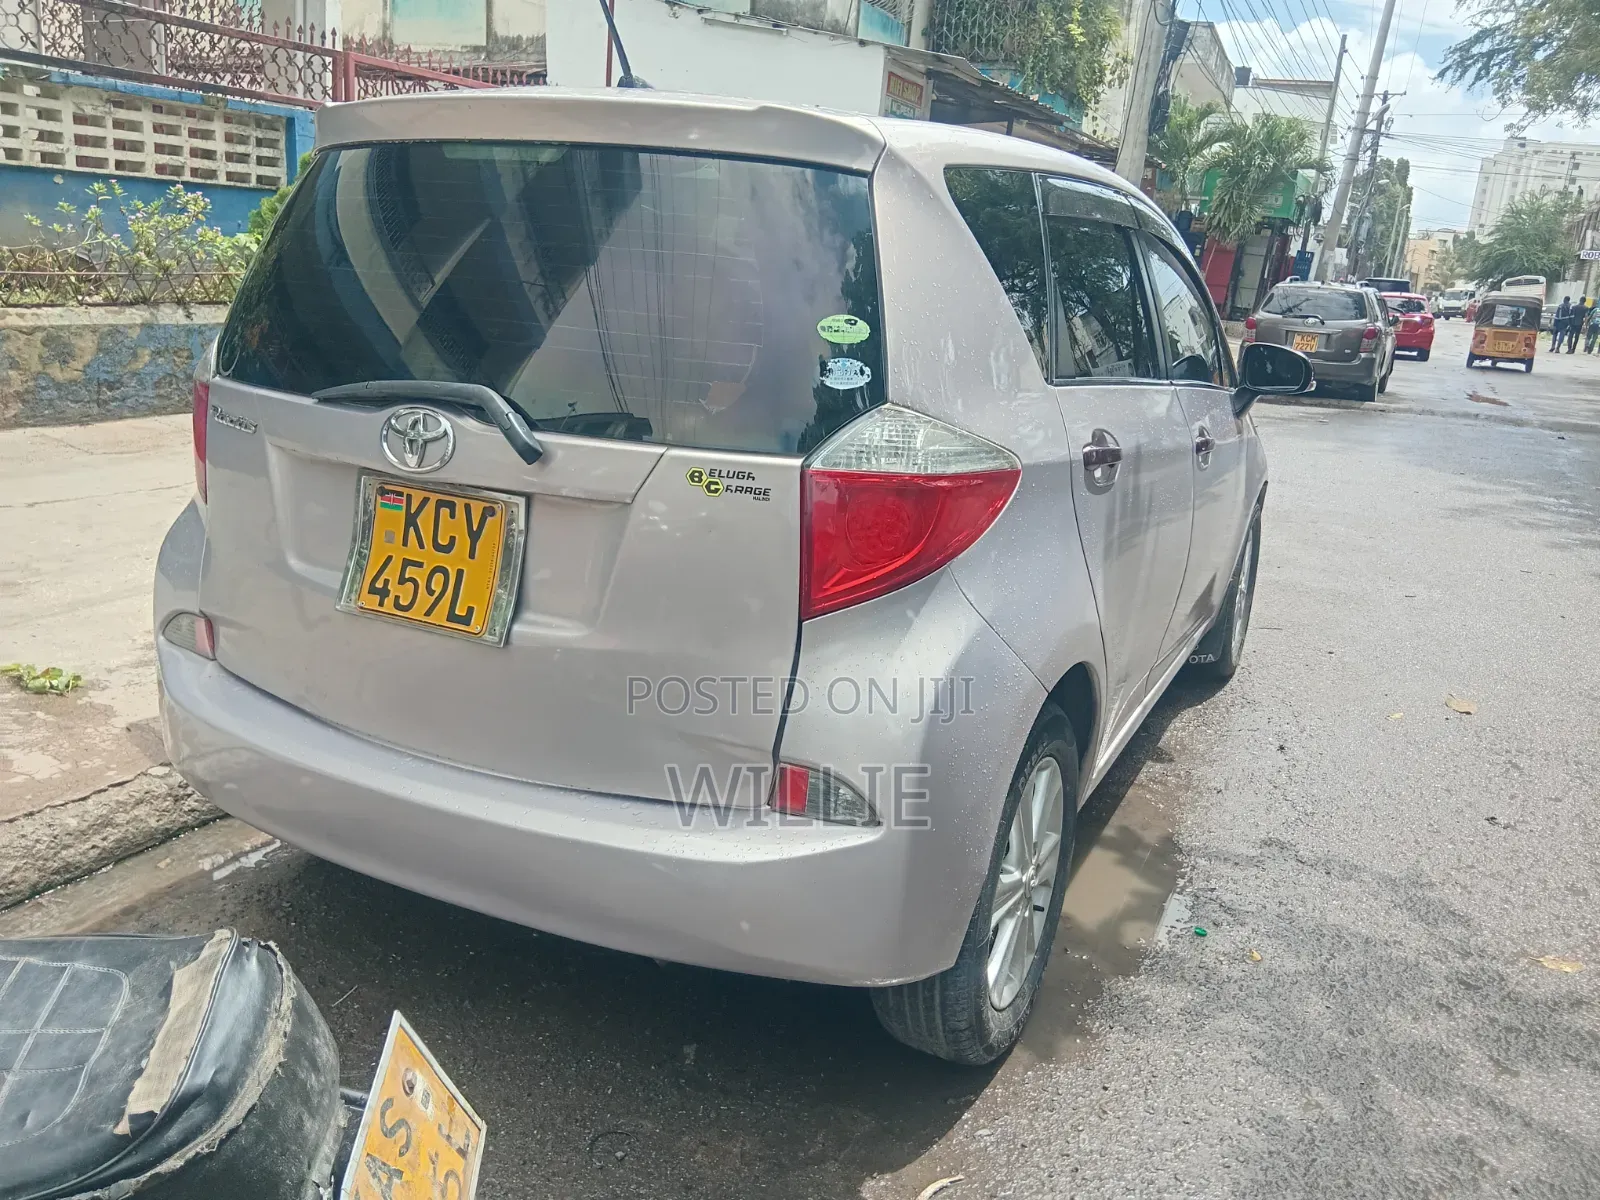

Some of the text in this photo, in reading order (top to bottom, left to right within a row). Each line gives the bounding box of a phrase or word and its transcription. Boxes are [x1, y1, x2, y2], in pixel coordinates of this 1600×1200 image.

[1295, 342, 1315, 352] 727V
[703, 478, 772, 497] GARAGE
[401, 493, 495, 560] KCY
[367, 554, 476, 627] 459L
[1189, 653, 1215, 664] OTA
[352, 1097, 413, 1200] AS
